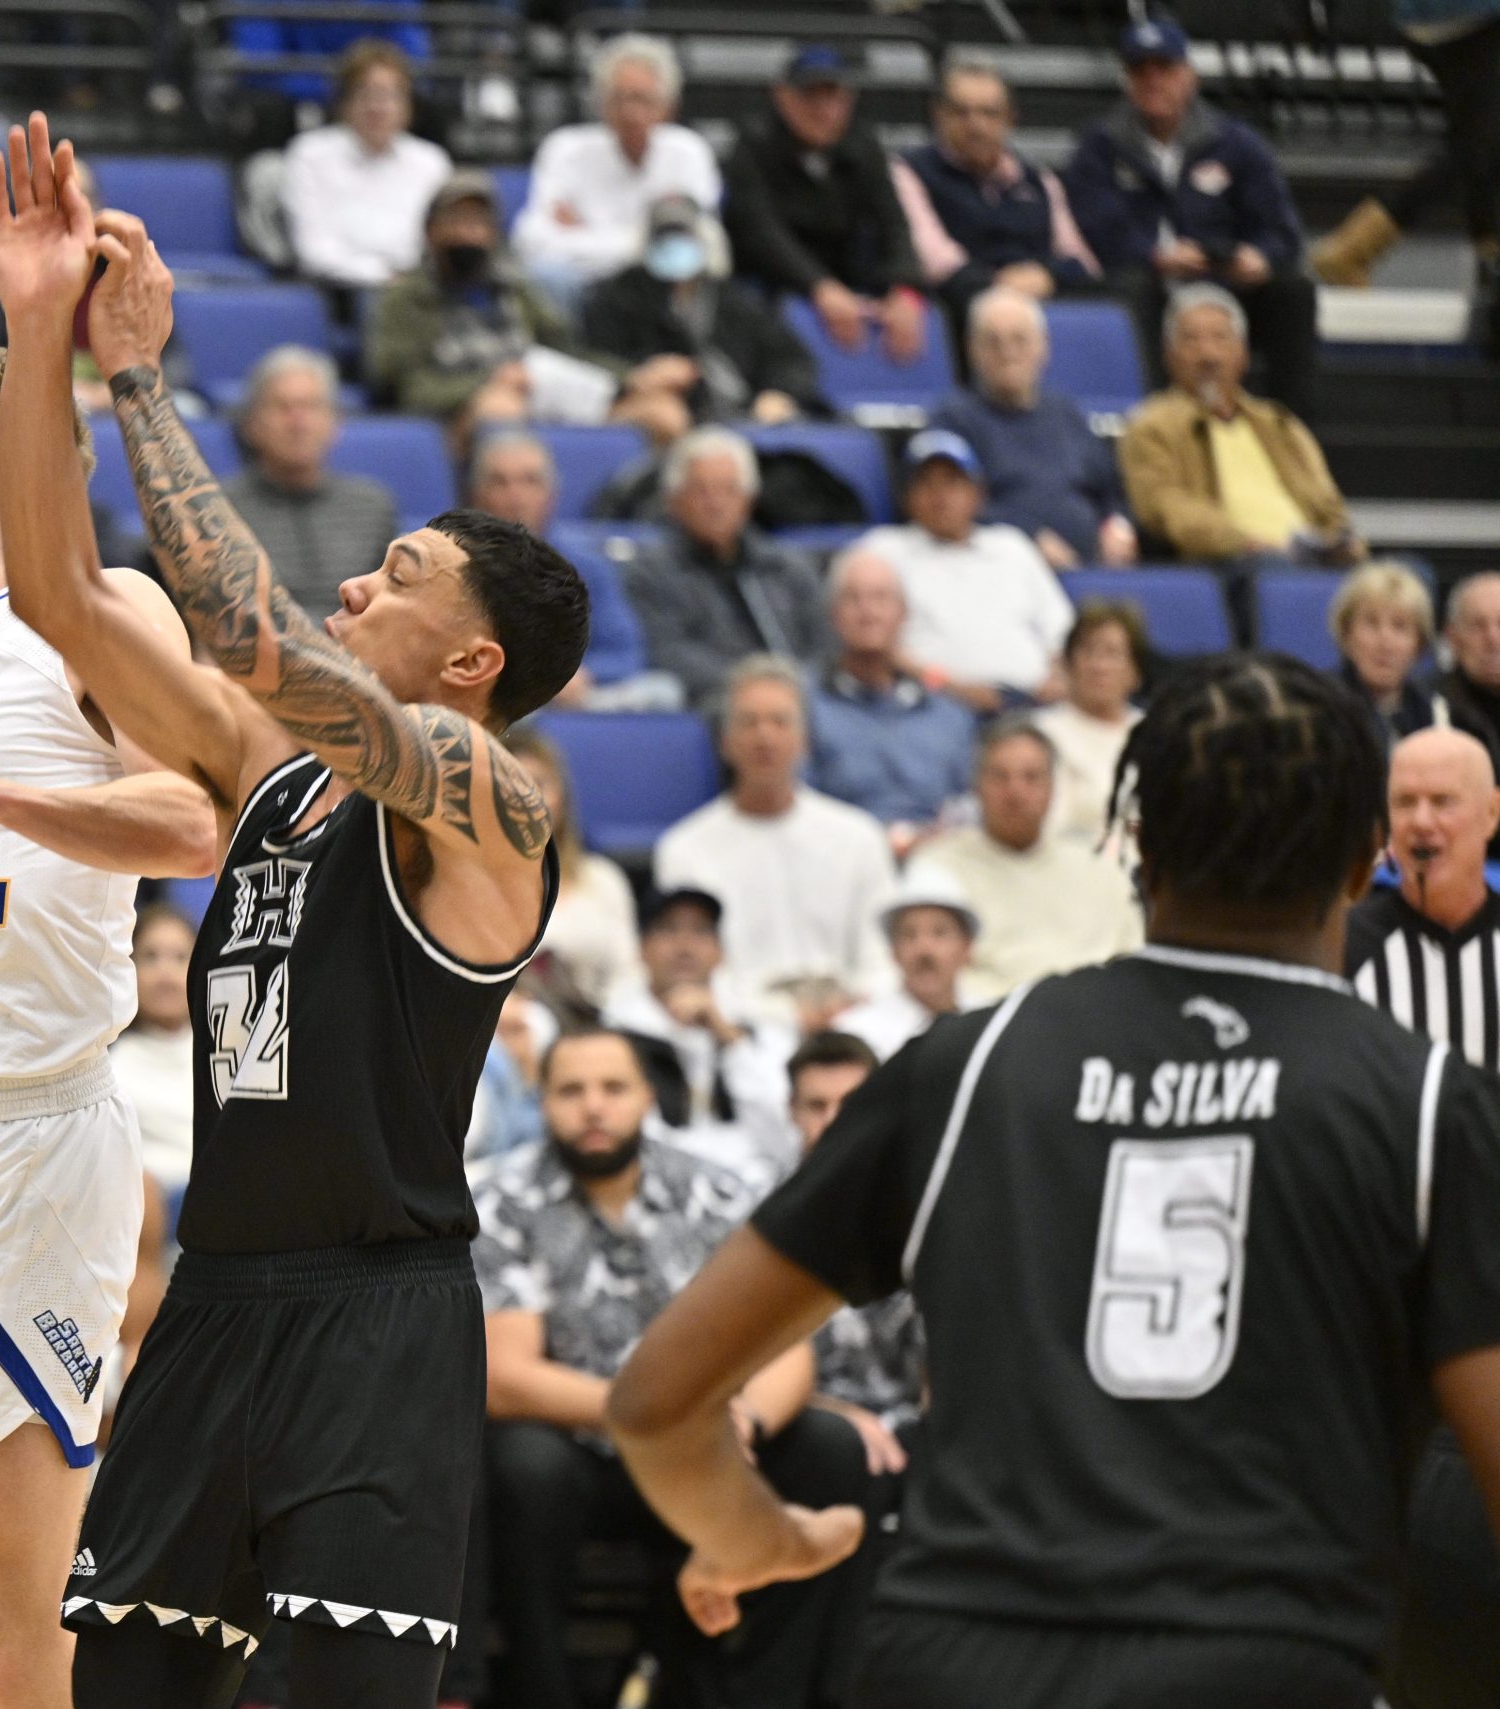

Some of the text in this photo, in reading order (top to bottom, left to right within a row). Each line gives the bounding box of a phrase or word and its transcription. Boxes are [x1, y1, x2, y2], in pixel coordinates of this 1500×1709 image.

[1143, 1056, 1282, 1128] SILVA
[1084, 1133, 1256, 1401] 5
[32, 1309, 88, 1395] BARBARA
